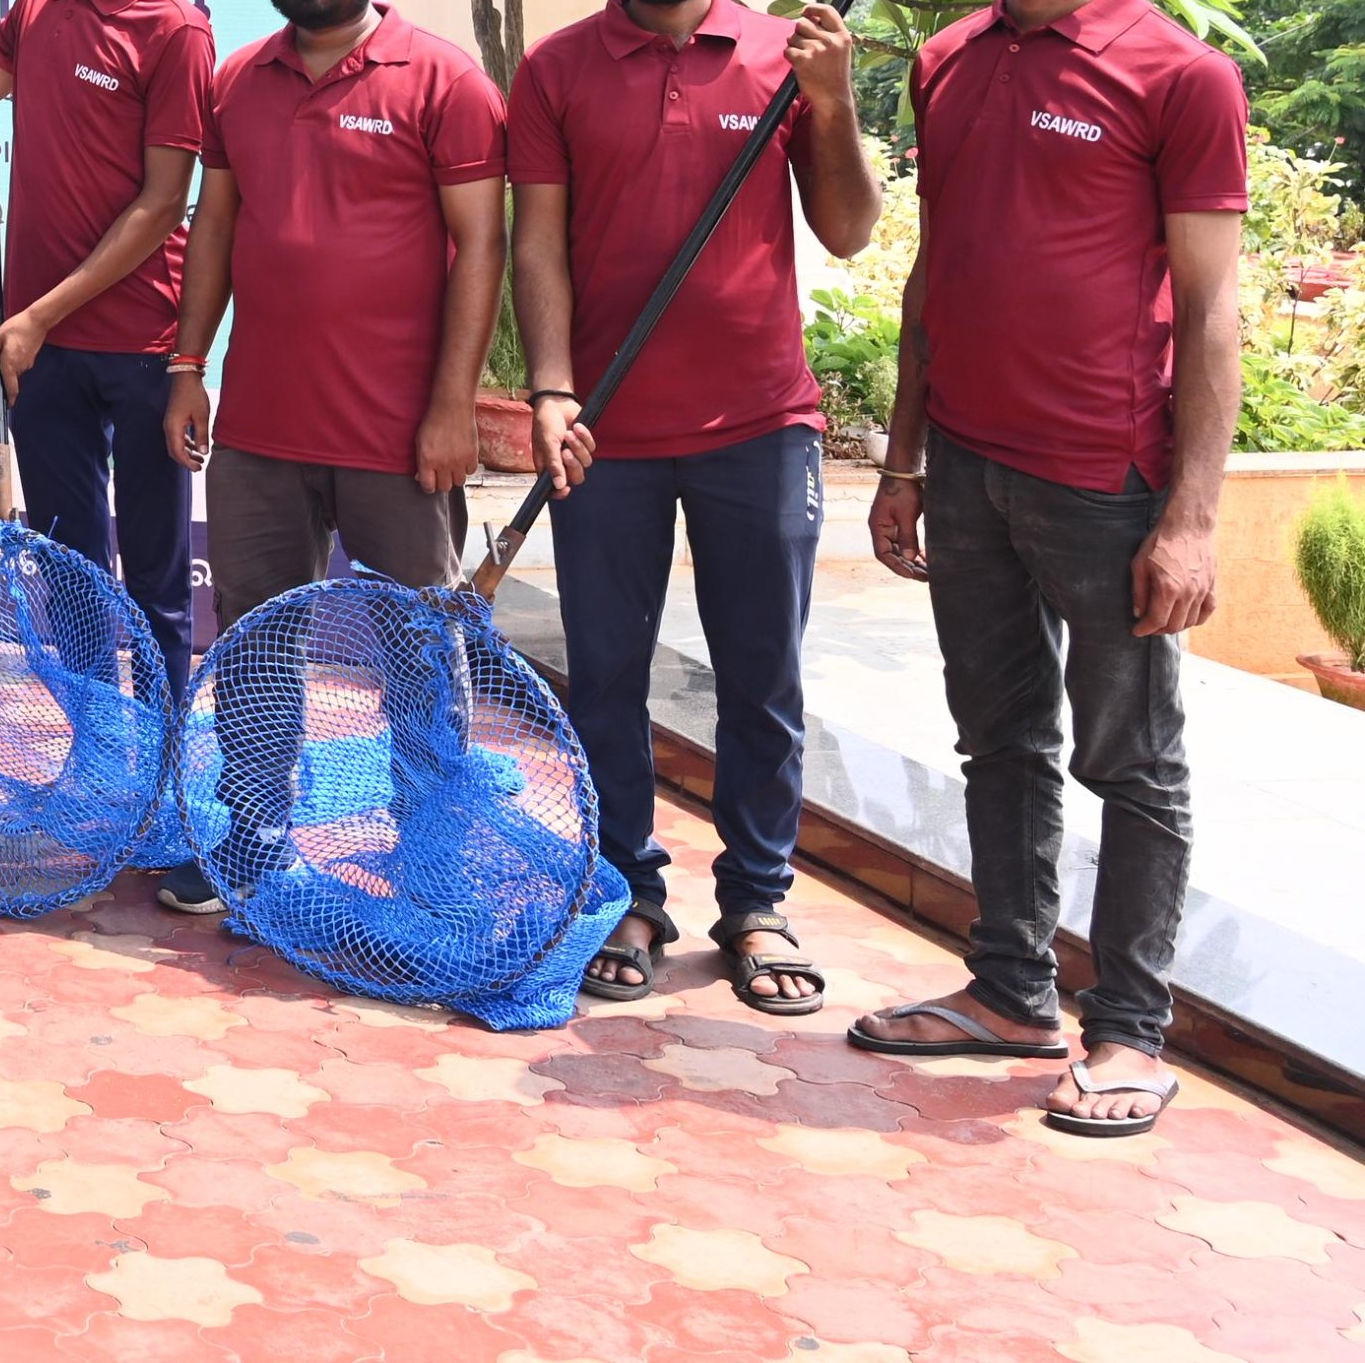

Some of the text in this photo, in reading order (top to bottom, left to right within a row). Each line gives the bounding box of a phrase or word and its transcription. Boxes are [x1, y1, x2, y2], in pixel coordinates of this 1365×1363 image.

[74, 63, 119, 91] VSAWRD
[339, 113, 394, 135] VSAWRD
[718, 114, 761, 131] VSAW
[1030, 110, 1102, 142] VSAWRD
